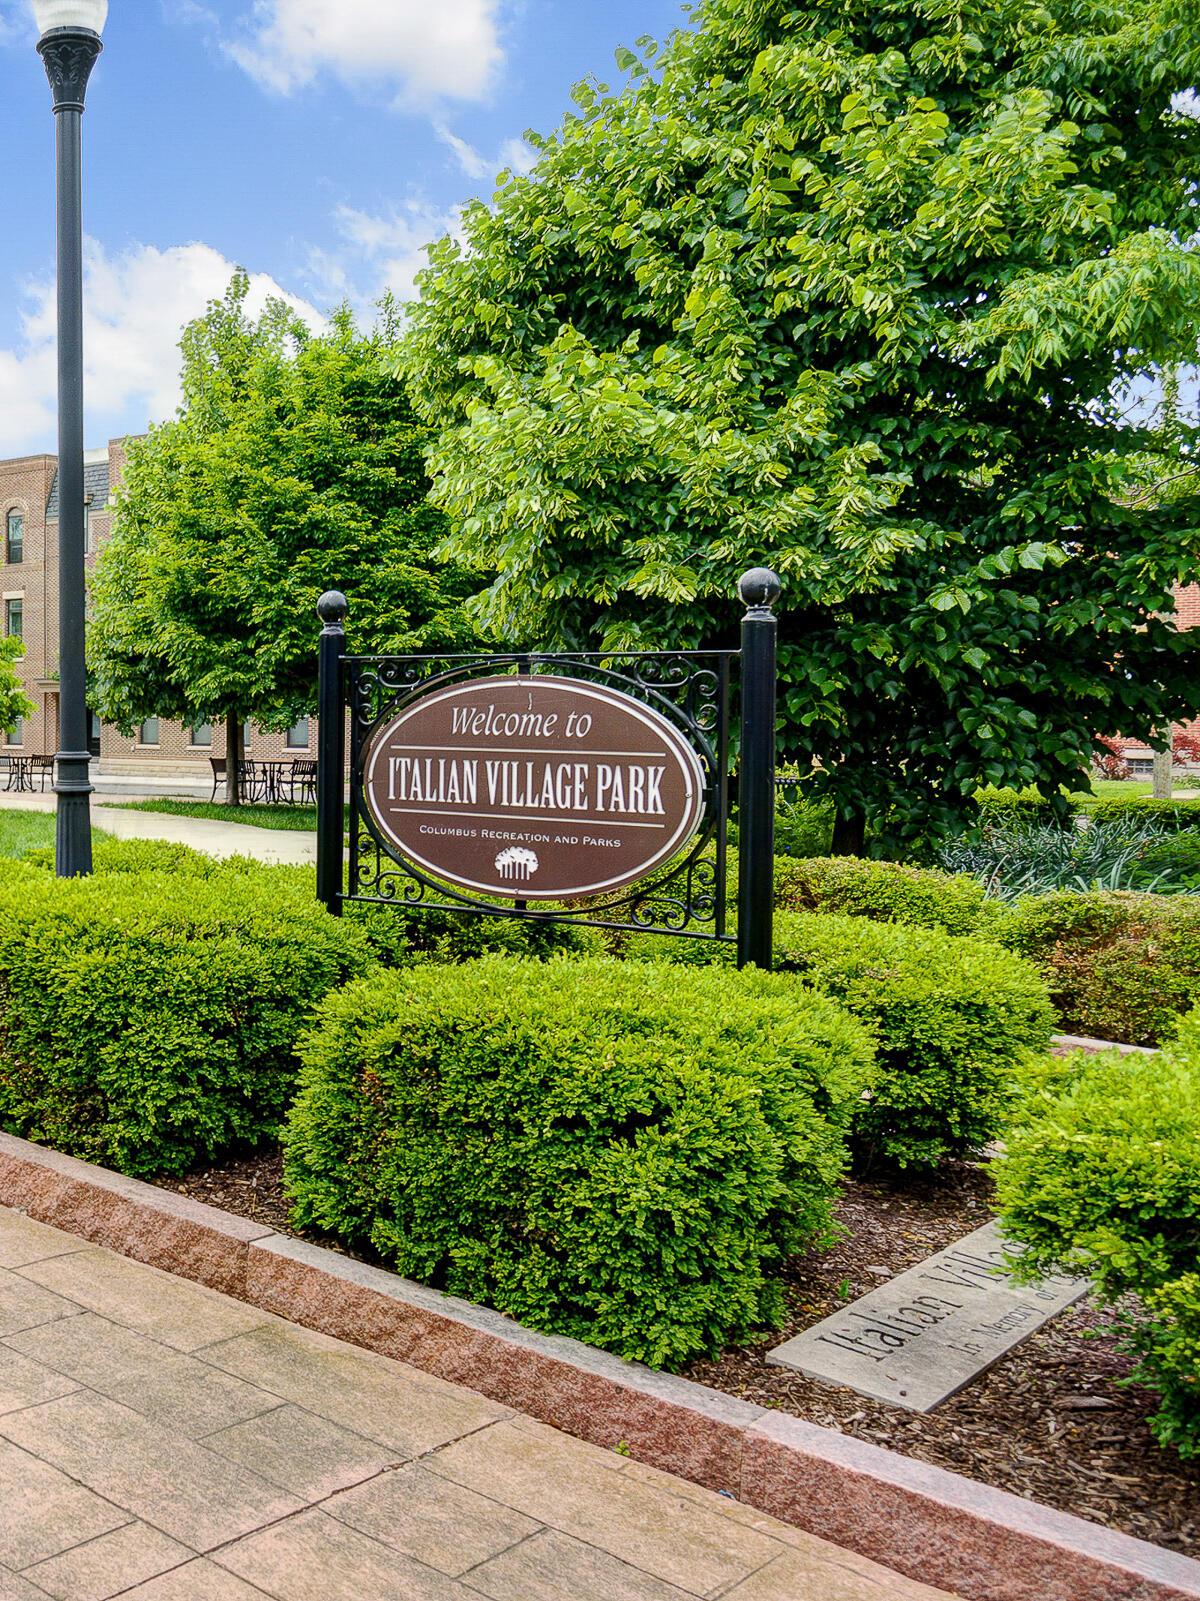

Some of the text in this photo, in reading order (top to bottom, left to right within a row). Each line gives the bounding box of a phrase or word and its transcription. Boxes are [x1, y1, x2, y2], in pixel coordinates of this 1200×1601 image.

[451, 704, 593, 738] Welcome to
[388, 757, 666, 815] ITALIAN VILLAGE PARK
[814, 1294, 964, 1363] Italian
[971, 1303, 1046, 1340] Memory
